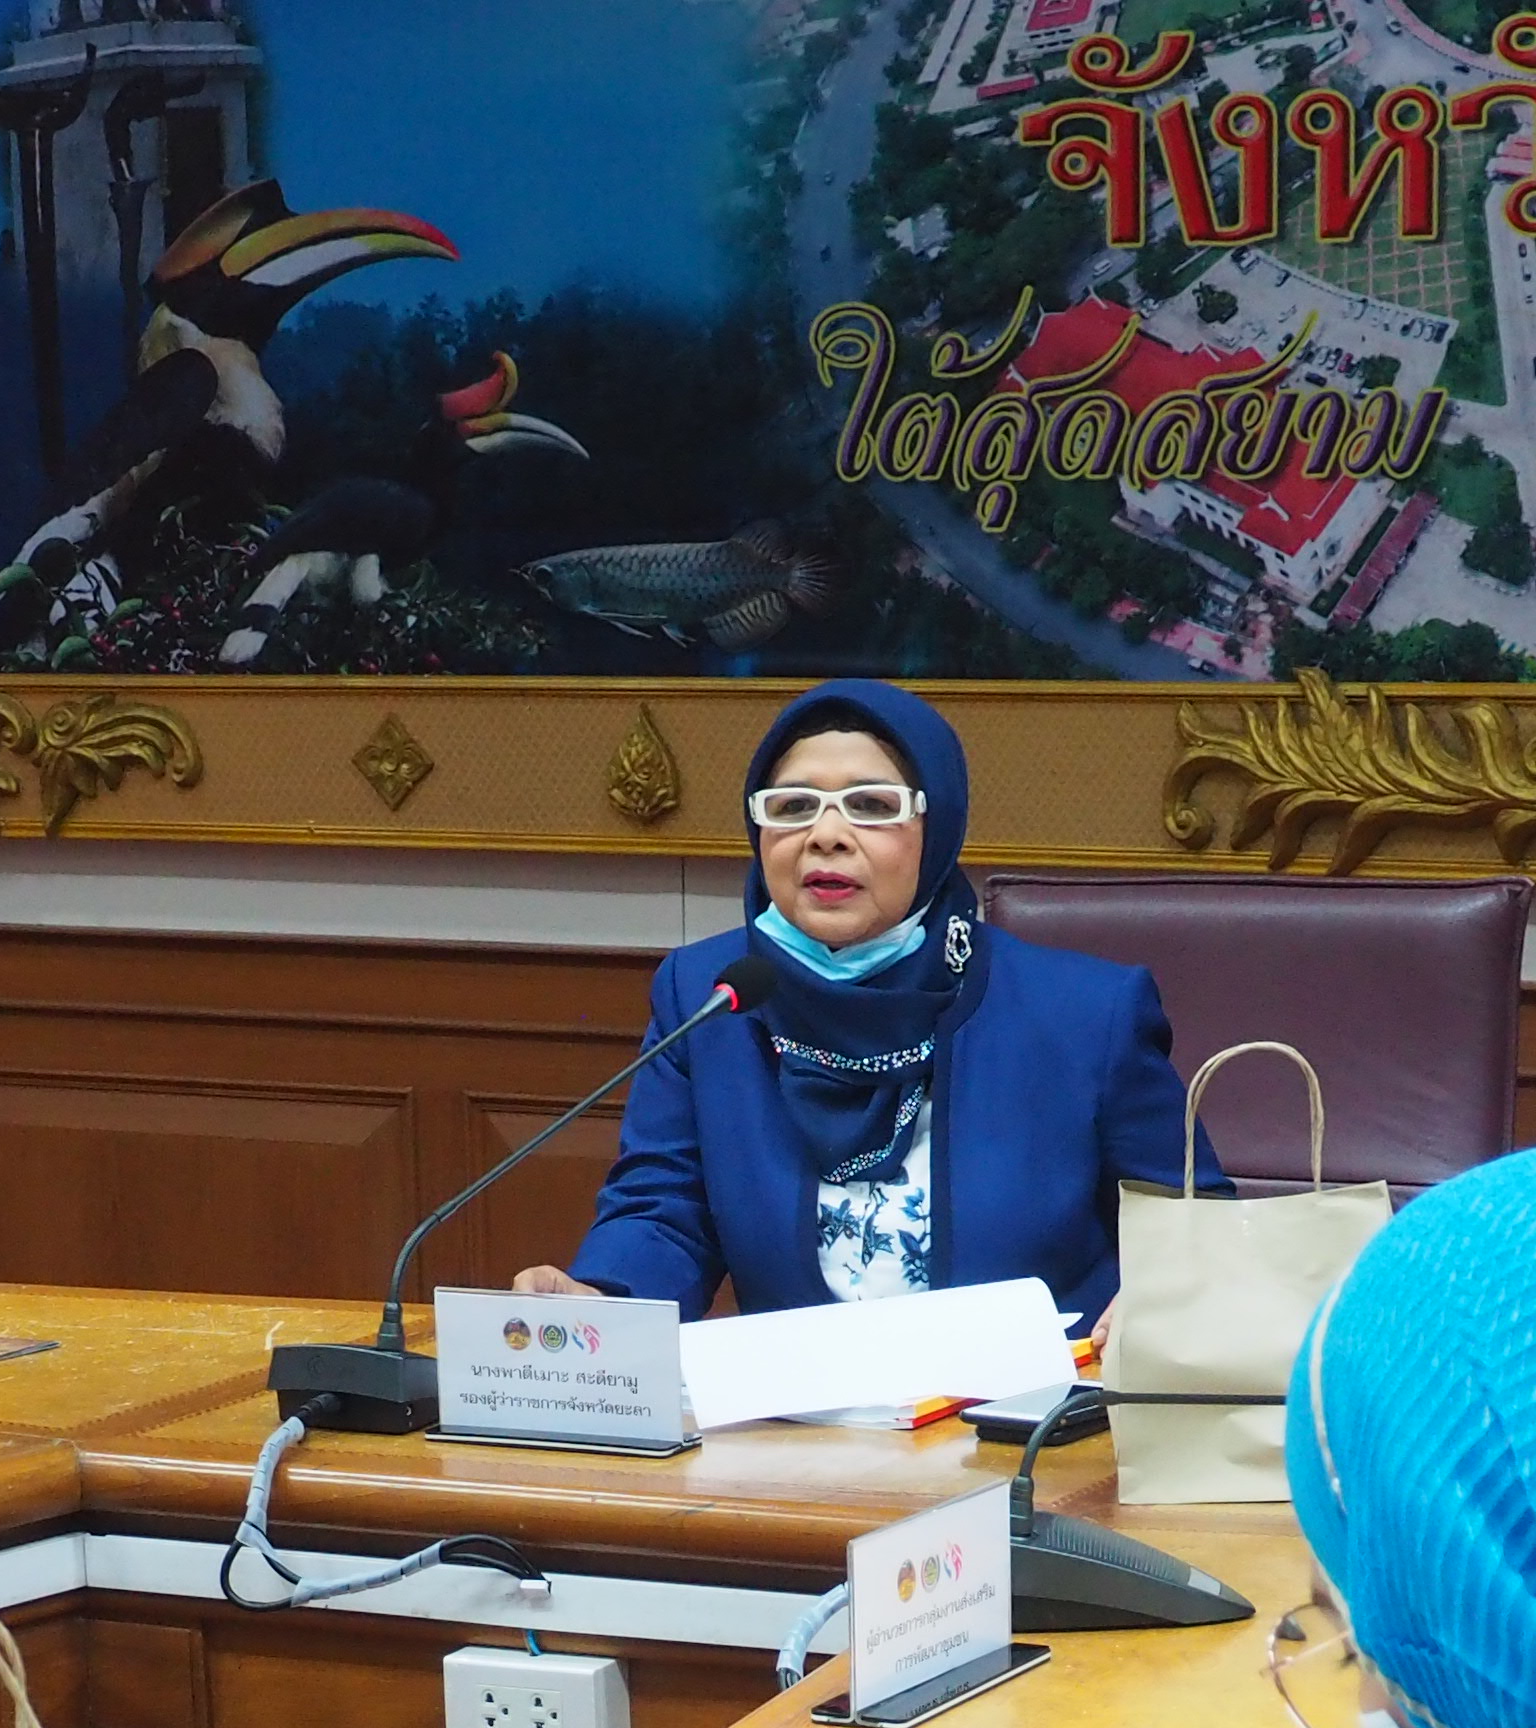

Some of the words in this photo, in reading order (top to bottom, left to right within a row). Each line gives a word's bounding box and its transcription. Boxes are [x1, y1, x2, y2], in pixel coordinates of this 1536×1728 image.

[809, 285, 1448, 533] ใต้สุดสยาม
[459, 1390, 652, 1418] รองผู้ว่าราชการจังหวัดยะลา
